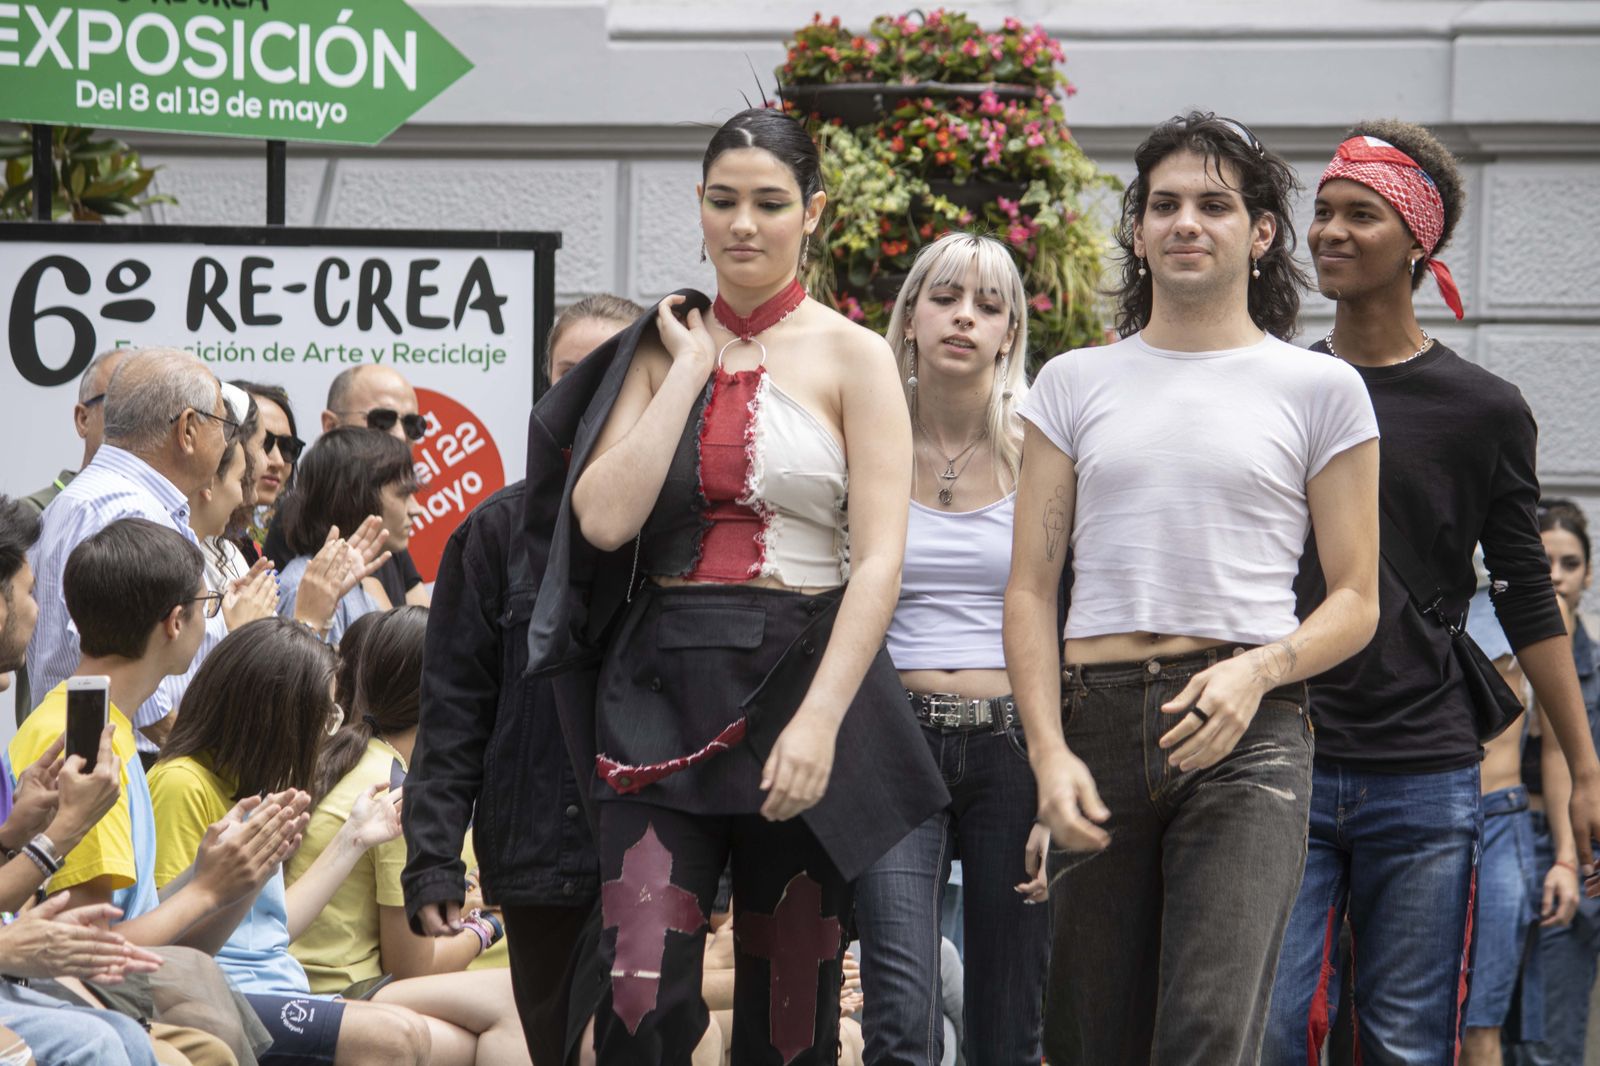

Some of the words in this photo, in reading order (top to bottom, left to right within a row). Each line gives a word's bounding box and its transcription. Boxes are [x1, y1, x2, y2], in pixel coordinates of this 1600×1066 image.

[0, 3, 417, 91] EXPOSICIÓN
[76, 80, 122, 110] Del
[129, 83, 150, 112] 8
[156, 86, 181, 114] al
[188, 87, 219, 116] 19
[226, 90, 262, 119] de
[269, 98, 348, 129] mayo
[186, 256, 508, 335] RE-CREA
[263, 342, 295, 362] de
[302, 342, 363, 363] Arte
[393, 343, 506, 372] Reciclaje
[436, 421, 486, 468] 22
